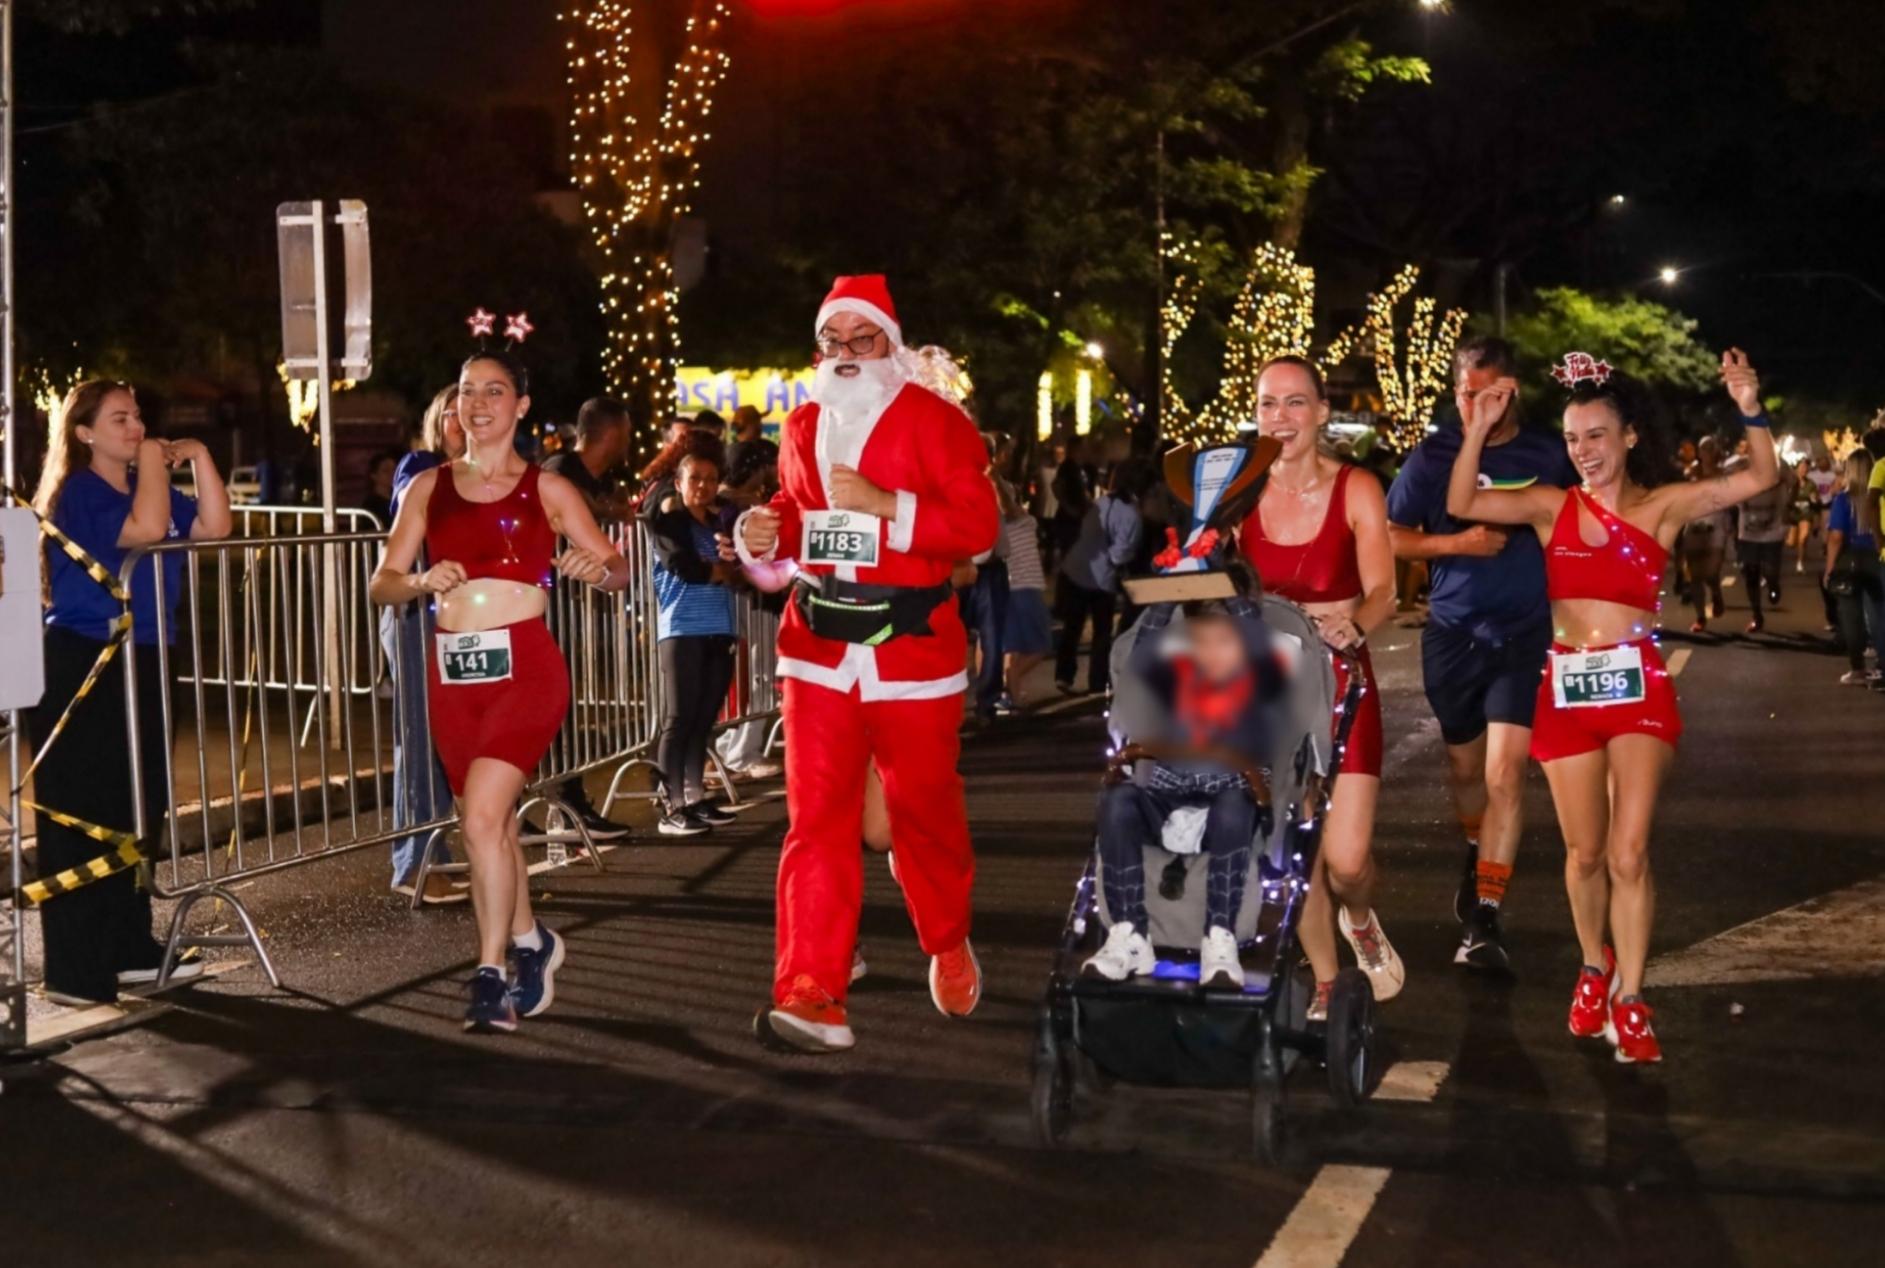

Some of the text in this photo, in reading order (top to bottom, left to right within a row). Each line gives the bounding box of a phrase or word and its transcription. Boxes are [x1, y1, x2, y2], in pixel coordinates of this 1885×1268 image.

[817, 532, 862, 552] 1183
[455, 652, 488, 671] 141
[1575, 671, 1628, 694] 1196
